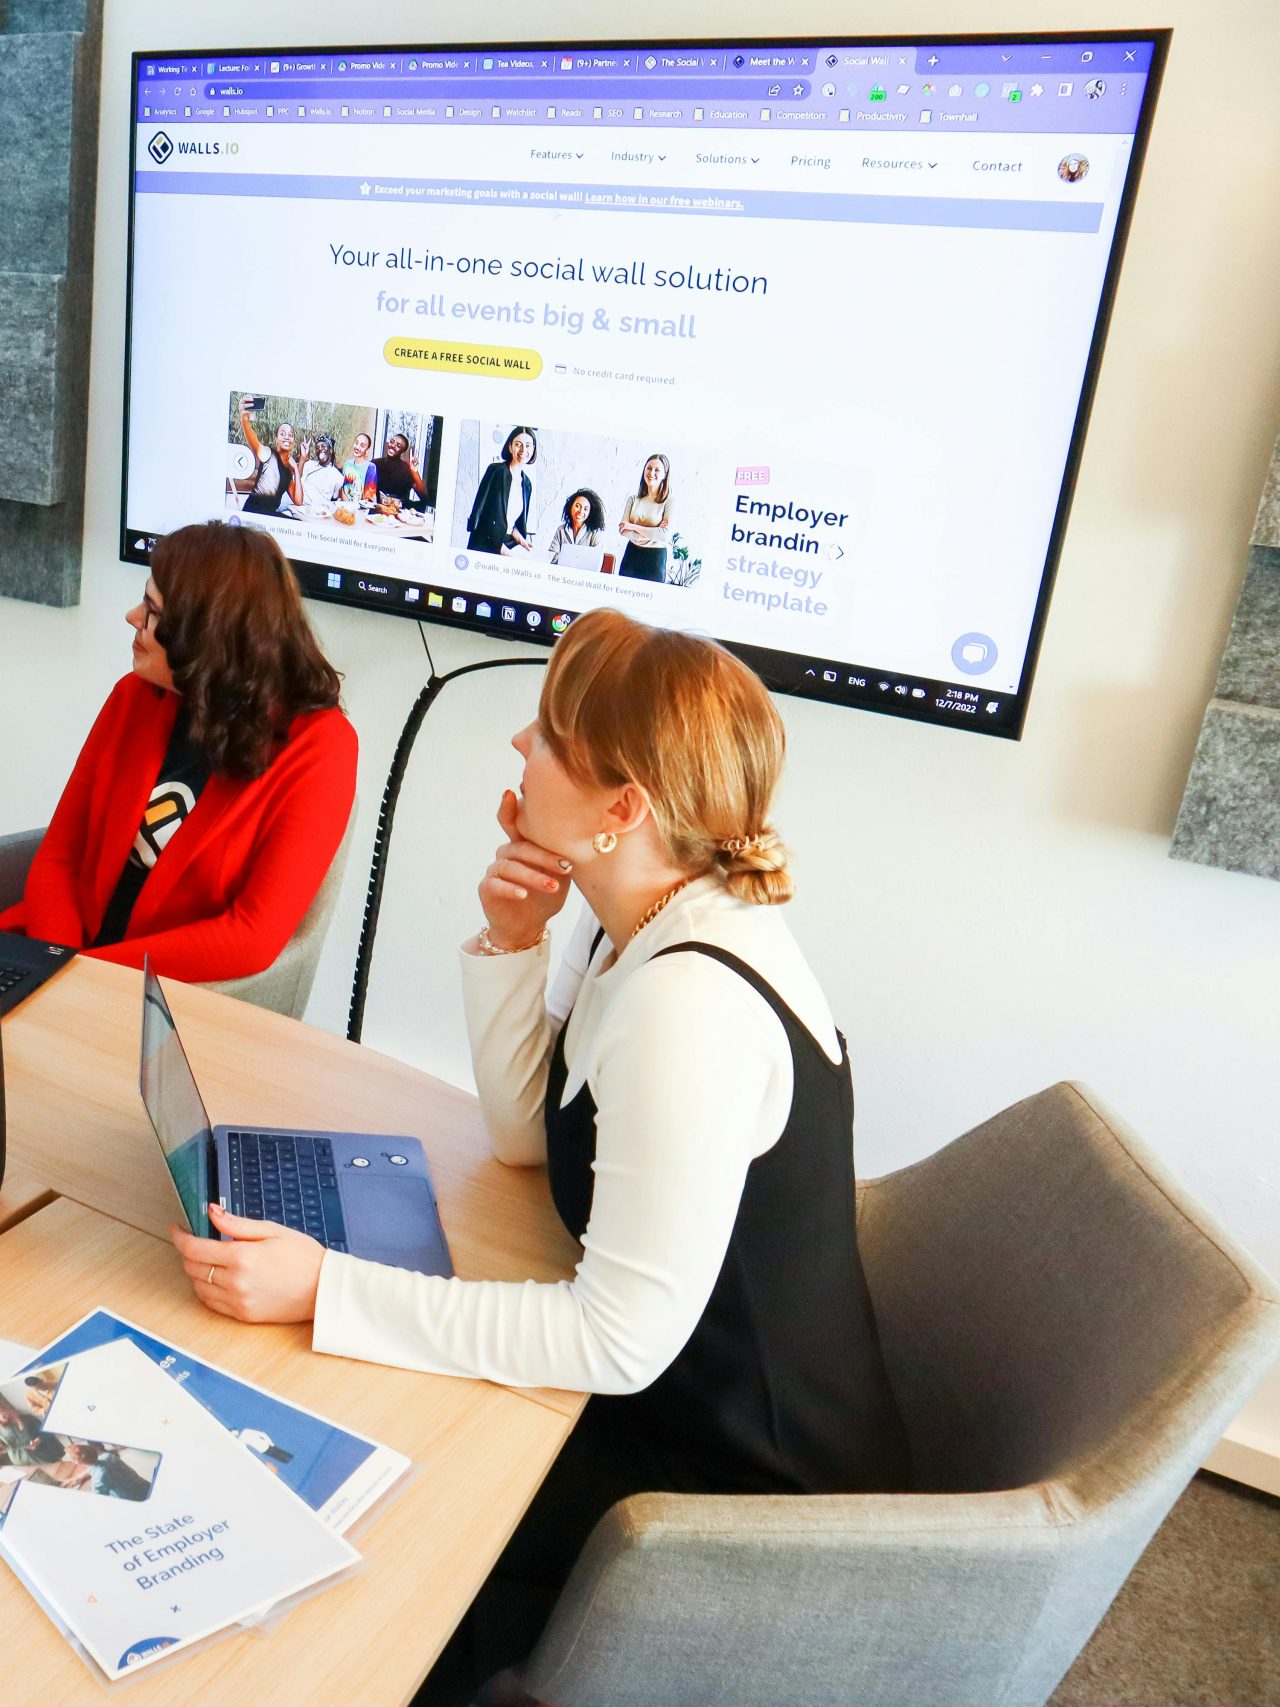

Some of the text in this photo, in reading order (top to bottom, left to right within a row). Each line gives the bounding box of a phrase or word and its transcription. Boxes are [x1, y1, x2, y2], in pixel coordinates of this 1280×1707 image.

[350, 62, 370, 70] Promo
[422, 60, 443, 69] Promo
[498, 60, 508, 68] Tea
[593, 58, 617, 67] Partne
[661, 57, 699, 67] The Social
[750, 57, 771, 66] Meet
[772, 57, 786, 66] the
[843, 55, 890, 66] Social Wall
[219, 64, 240, 72] Lecture:
[154, 107, 177, 117] Analytics
[195, 107, 215, 117] Google
[234, 107, 258, 117] Hubspot
[278, 107, 290, 116] PPC
[353, 107, 375, 116] Notion
[396, 107, 436, 116] Social Media
[459, 107, 482, 118] Design
[506, 108, 536, 117] Watchlist
[561, 108, 582, 117] Reads
[608, 109, 623, 117] SEO
[649, 109, 682, 118] Research
[710, 110, 748, 119] Education
[776, 110, 827, 122] Competitors
[856, 111, 908, 123] Productivity
[938, 112, 978, 122] Townhall
[530, 148, 1025, 172] Features Industry Solutions Pricing Resources Contact
[374, 183, 404, 195] Exceed
[405, 186, 426, 198] your
[426, 185, 473, 199] marketing
[473, 187, 498, 200] goals
[499, 187, 521, 199] with
[530, 188, 558, 201] social
[585, 192, 613, 204] Learn
[615, 192, 637, 204] how
[638, 194, 649, 205] in
[650, 196, 669, 206] our
[670, 194, 691, 206] free
[692, 196, 744, 209] webinars.
[329, 243, 768, 294] Your all-in-one social wall solution
[376, 290, 697, 339] for all events big & small
[394, 347, 531, 370] CREATE A FREE SOCIAL WALL
[573, 366, 586, 376] No
[587, 368, 612, 379] credit
[614, 370, 634, 381] card
[737, 470, 766, 481] FREE
[735, 494, 849, 529] Employer
[306, 530, 319, 541] The
[319, 534, 338, 544] Social
[339, 536, 353, 546] Wall
[354, 538, 363, 548] for
[731, 523, 820, 554] brandin
[726, 555, 823, 589] strategy
[367, 584, 388, 595] Search
[547, 573, 561, 584] The
[562, 576, 584, 588] Social
[585, 579, 602, 591] Wall
[603, 582, 614, 593] for
[615, 585, 653, 601] Everyone)
[723, 581, 828, 616] template
[847, 676, 866, 687] ENG
[946, 689, 979, 703] 2:18 PM
[935, 698, 977, 714] 12/7/2022
[103, 1514, 195, 1555] The State
[123, 1519, 231, 1572] of Employer
[135, 1546, 225, 1591] Branding
